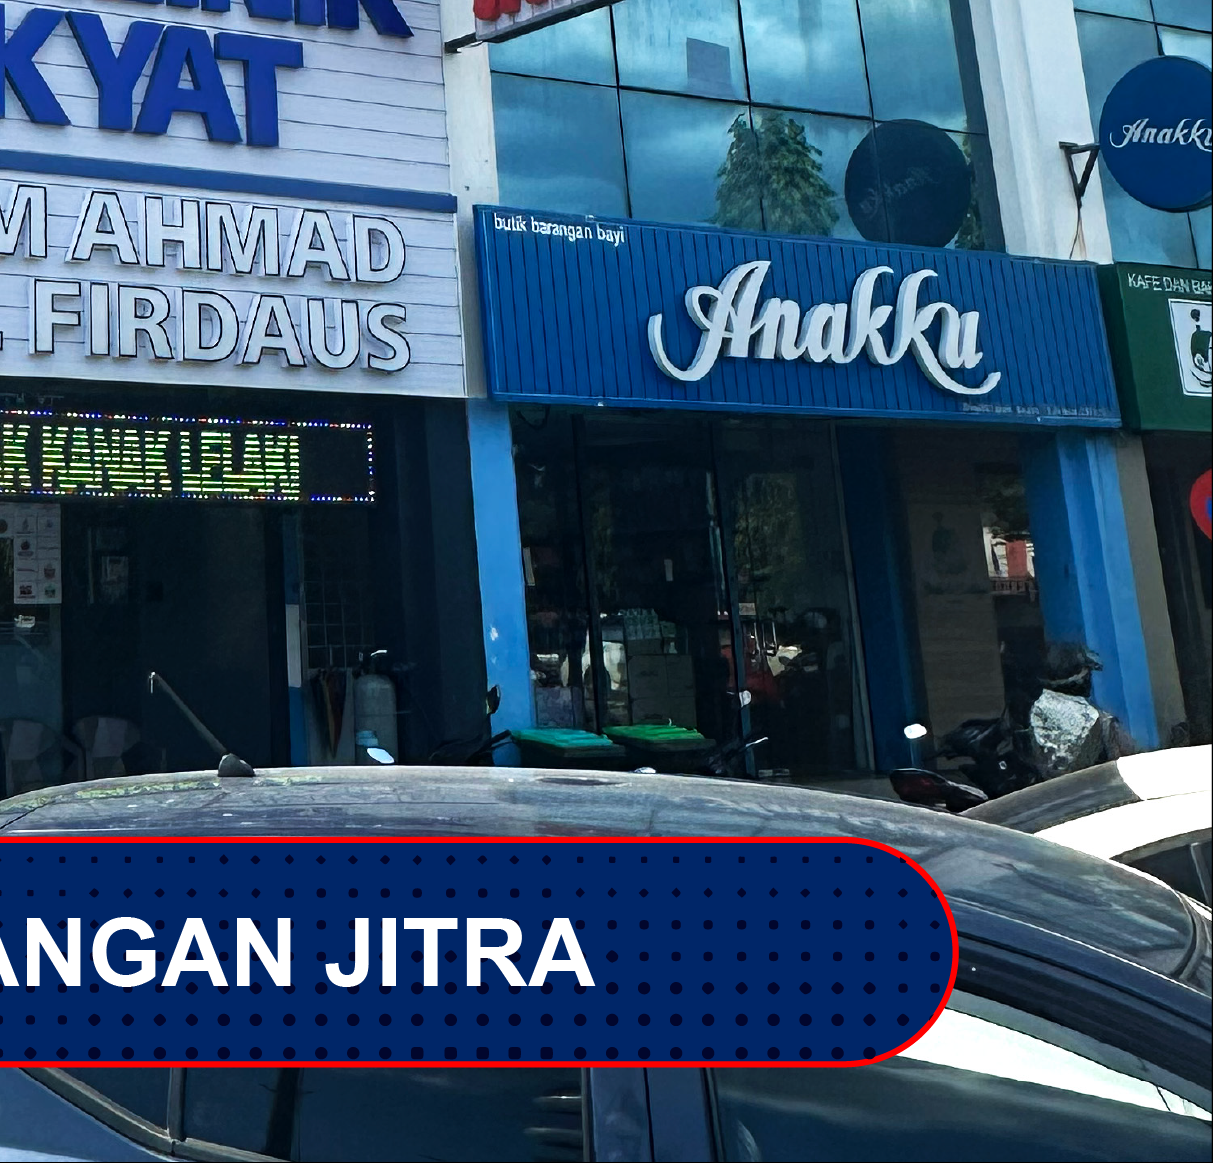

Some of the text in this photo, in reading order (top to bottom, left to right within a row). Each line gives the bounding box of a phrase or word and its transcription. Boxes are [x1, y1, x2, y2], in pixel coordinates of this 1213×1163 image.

[65, 187, 407, 285] AHMAD
[531, 217, 593, 242] barangan
[596, 223, 625, 247] bayi
[1128, 273, 1162, 291] KAFE
[1163, 276, 1189, 293] DAN
[29, 277, 412, 374] FIRDAUS
[648, 261, 1001, 396] Anakku
[42, 424, 172, 492] KANAK
[180, 430, 300, 494] LELAKI
